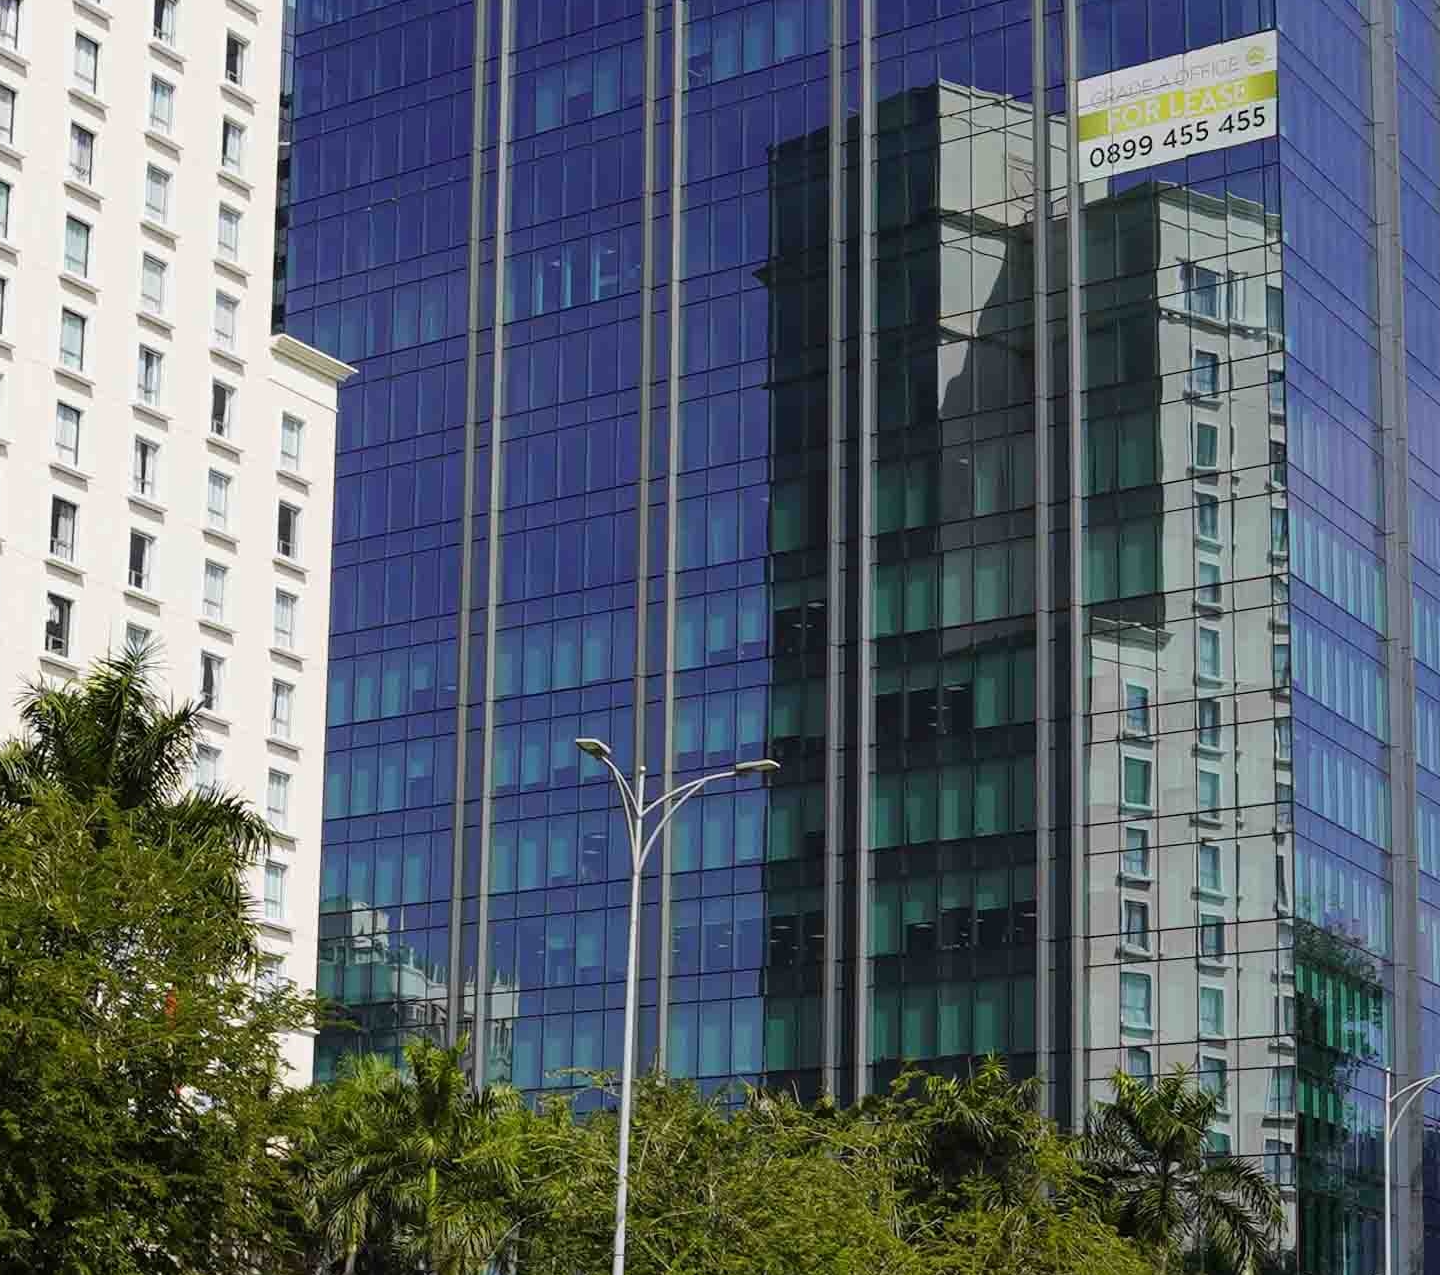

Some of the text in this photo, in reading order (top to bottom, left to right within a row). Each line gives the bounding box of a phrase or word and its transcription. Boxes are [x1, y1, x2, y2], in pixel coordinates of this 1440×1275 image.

[1090, 77, 1153, 103] GRADE
[1175, 56, 1240, 87] OFFICE
[1107, 81, 1248, 135] FOR LEASE
[1090, 106, 1265, 168] 0899 455 455
